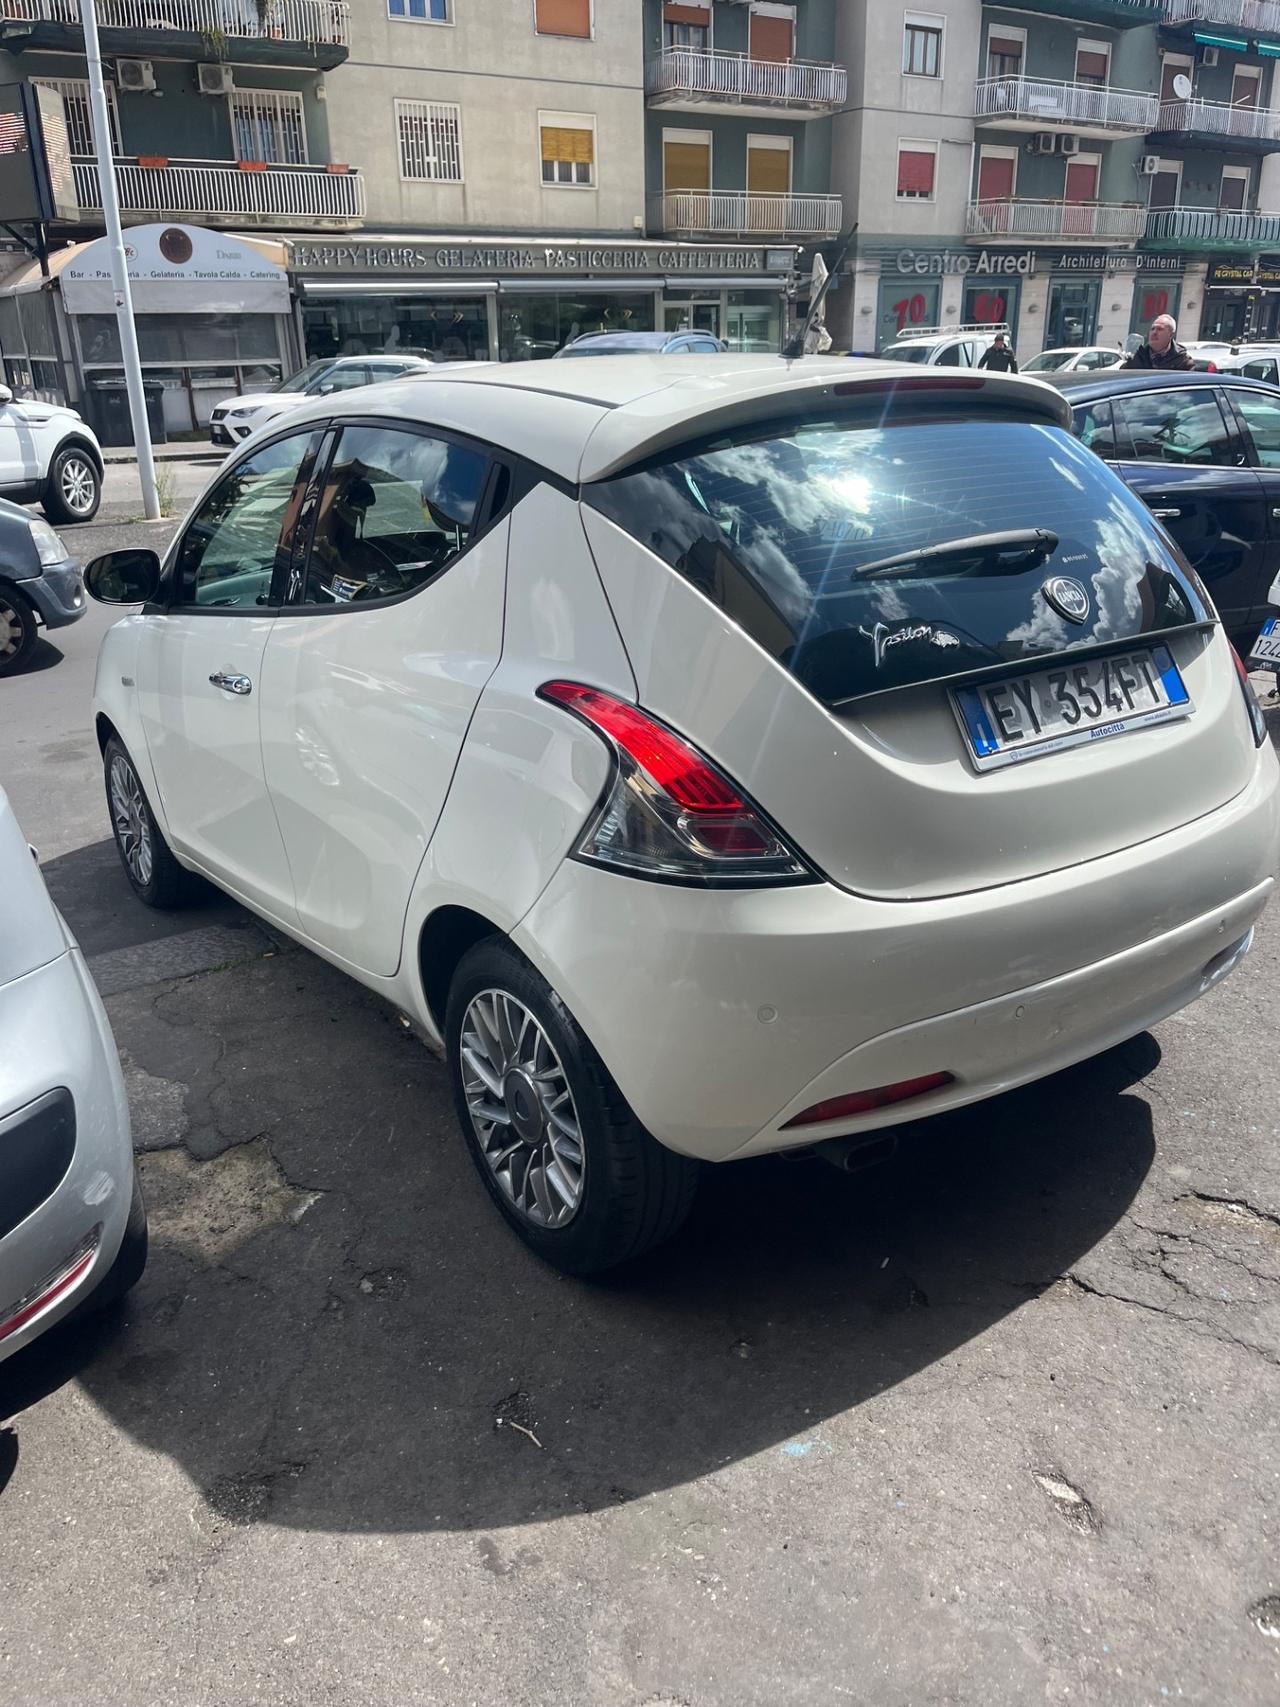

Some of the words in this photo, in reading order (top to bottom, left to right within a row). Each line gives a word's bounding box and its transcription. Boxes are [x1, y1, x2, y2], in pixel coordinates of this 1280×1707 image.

[294, 245, 361, 267] HAPPY
[366, 247, 427, 268] HOURS
[436, 248, 536, 268] GELATERIA
[544, 248, 651, 268] PASTICCERIA
[658, 251, 760, 269] CAFFETTERIA
[896, 249, 971, 274] Centro
[975, 250, 1036, 273] Arredi
[1059, 253, 1127, 268] Architettura
[70, 270, 84, 278] Bar
[150, 270, 185, 278] Gelateria
[194, 270, 218, 278] Tavola
[220, 270, 241, 278] Calda
[250, 270, 280, 280] Catering
[859, 622, 933, 667] Ypsilon
[985, 679, 1042, 742] EY
